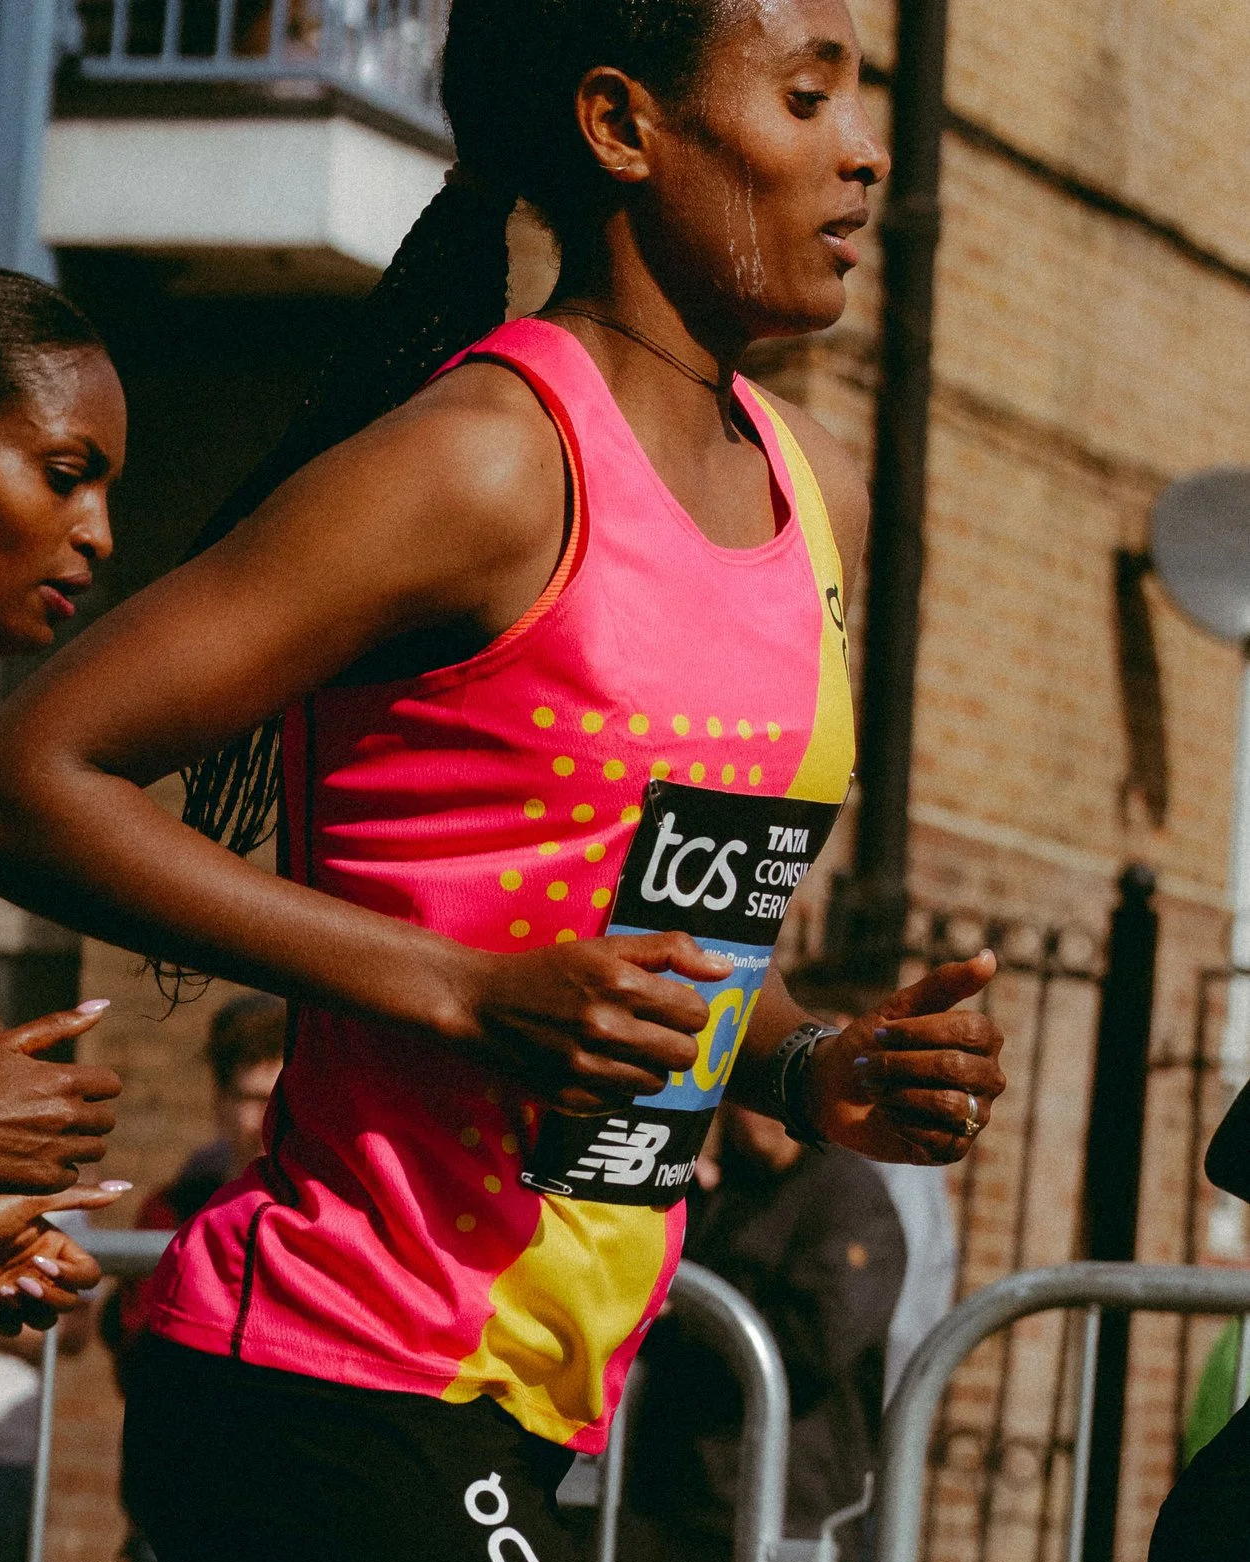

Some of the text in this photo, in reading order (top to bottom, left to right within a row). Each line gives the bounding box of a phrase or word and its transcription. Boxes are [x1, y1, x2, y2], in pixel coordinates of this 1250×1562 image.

[768, 825, 810, 853] TATA
[641, 812, 748, 911] tcs
[654, 1162, 690, 1187] new
